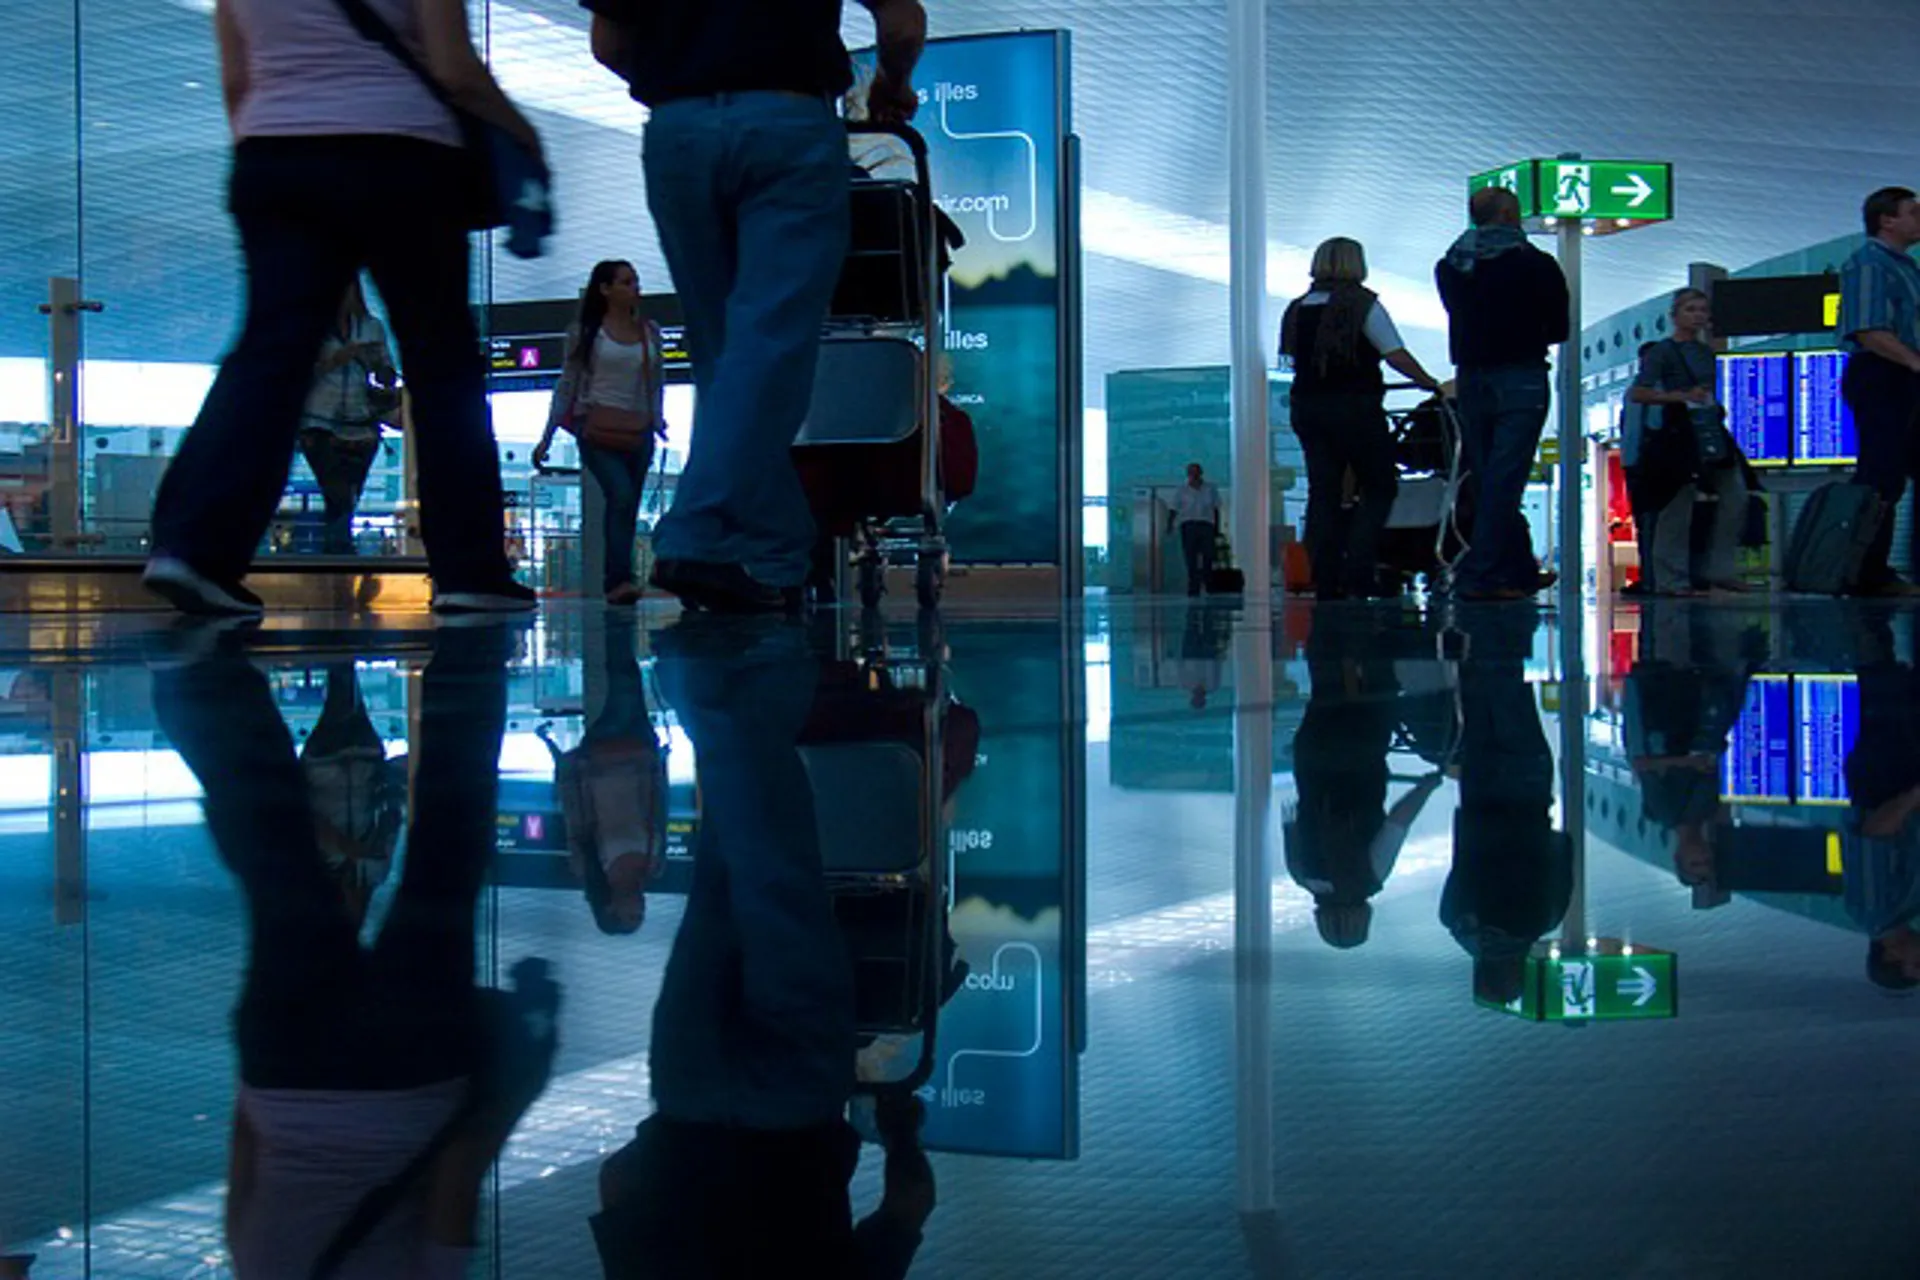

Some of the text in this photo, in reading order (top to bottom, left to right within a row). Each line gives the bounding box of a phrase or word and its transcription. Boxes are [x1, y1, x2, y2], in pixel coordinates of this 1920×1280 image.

[935, 82, 979, 102] illes
[944, 330, 988, 350] illes
[523, 350, 537, 366] A
